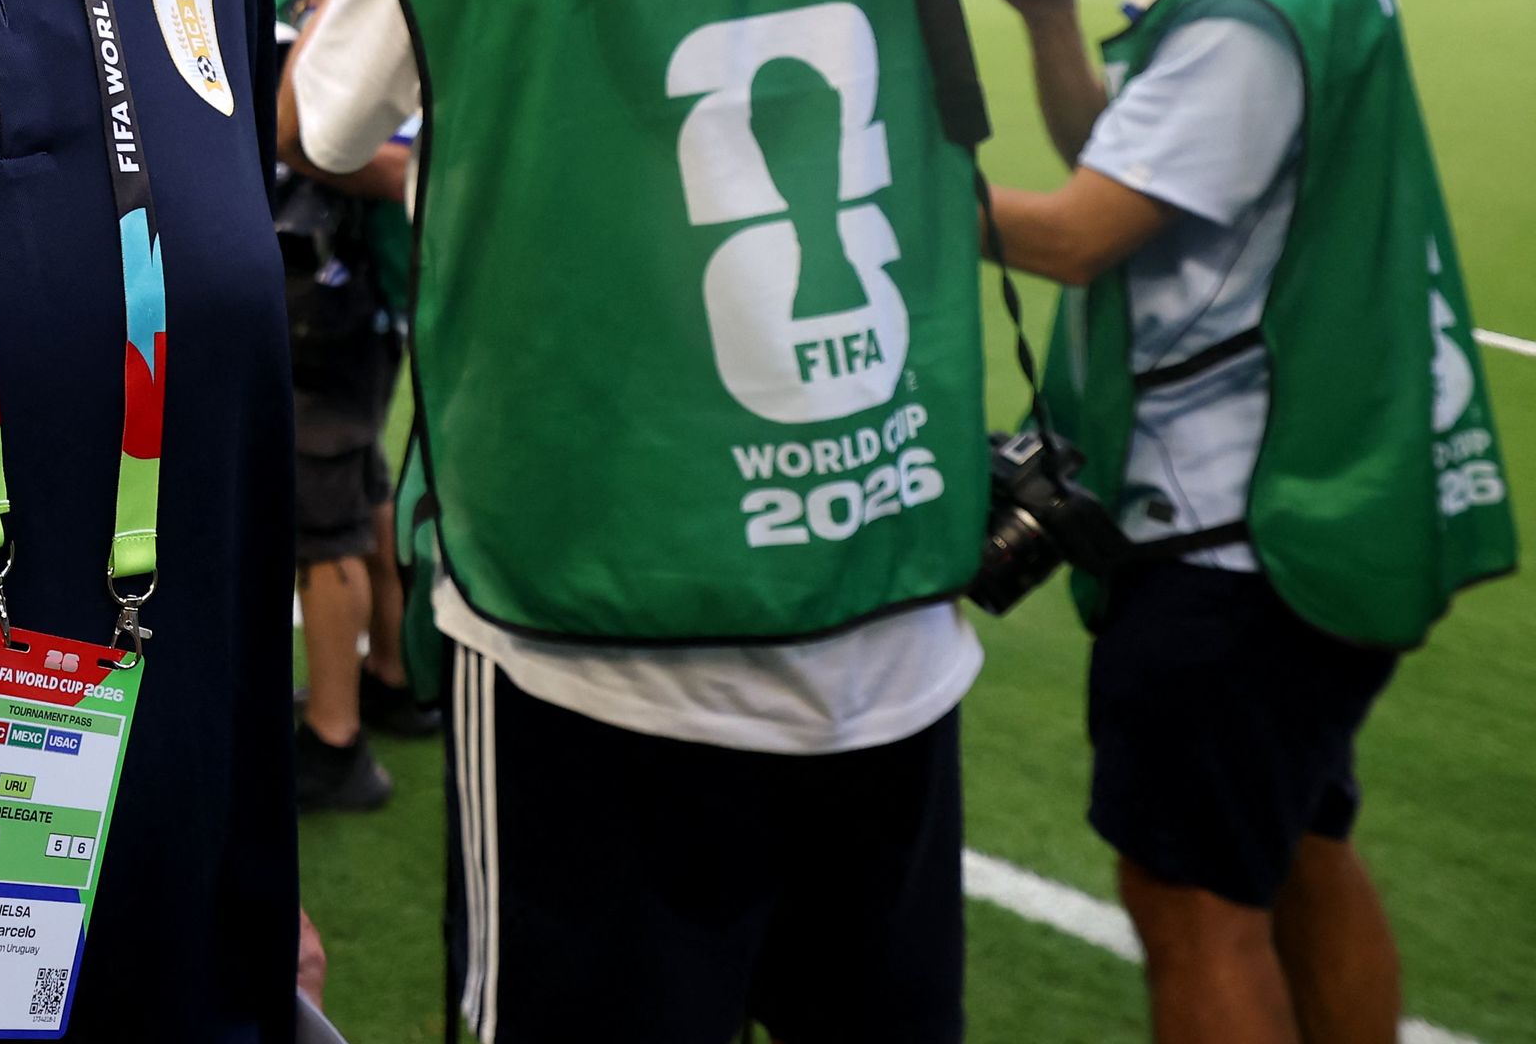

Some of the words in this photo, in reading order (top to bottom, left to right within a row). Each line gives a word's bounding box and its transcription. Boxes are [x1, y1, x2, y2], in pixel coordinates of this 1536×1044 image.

[111, 100, 140, 173] FIFA
[794, 327, 885, 384] FIFA
[731, 426, 882, 481] WORLD
[882, 402, 929, 454] CUP
[740, 446, 946, 549] 2026
[44, 649, 80, 673] 26
[15, 670, 59, 690] WORLD
[59, 678, 84, 695] CUP
[83, 683, 125, 703] 2026
[9, 705, 68, 723] TOURNAMENT
[69, 714, 93, 727] PASS
[11, 729, 43, 744] MEXC
[49, 735, 79, 749] USAC
[4, 780, 27, 792] URU
[54, 840, 63, 852] 5
[77, 842, 86, 854] 6
[6, 943, 40, 956] Uruguay
